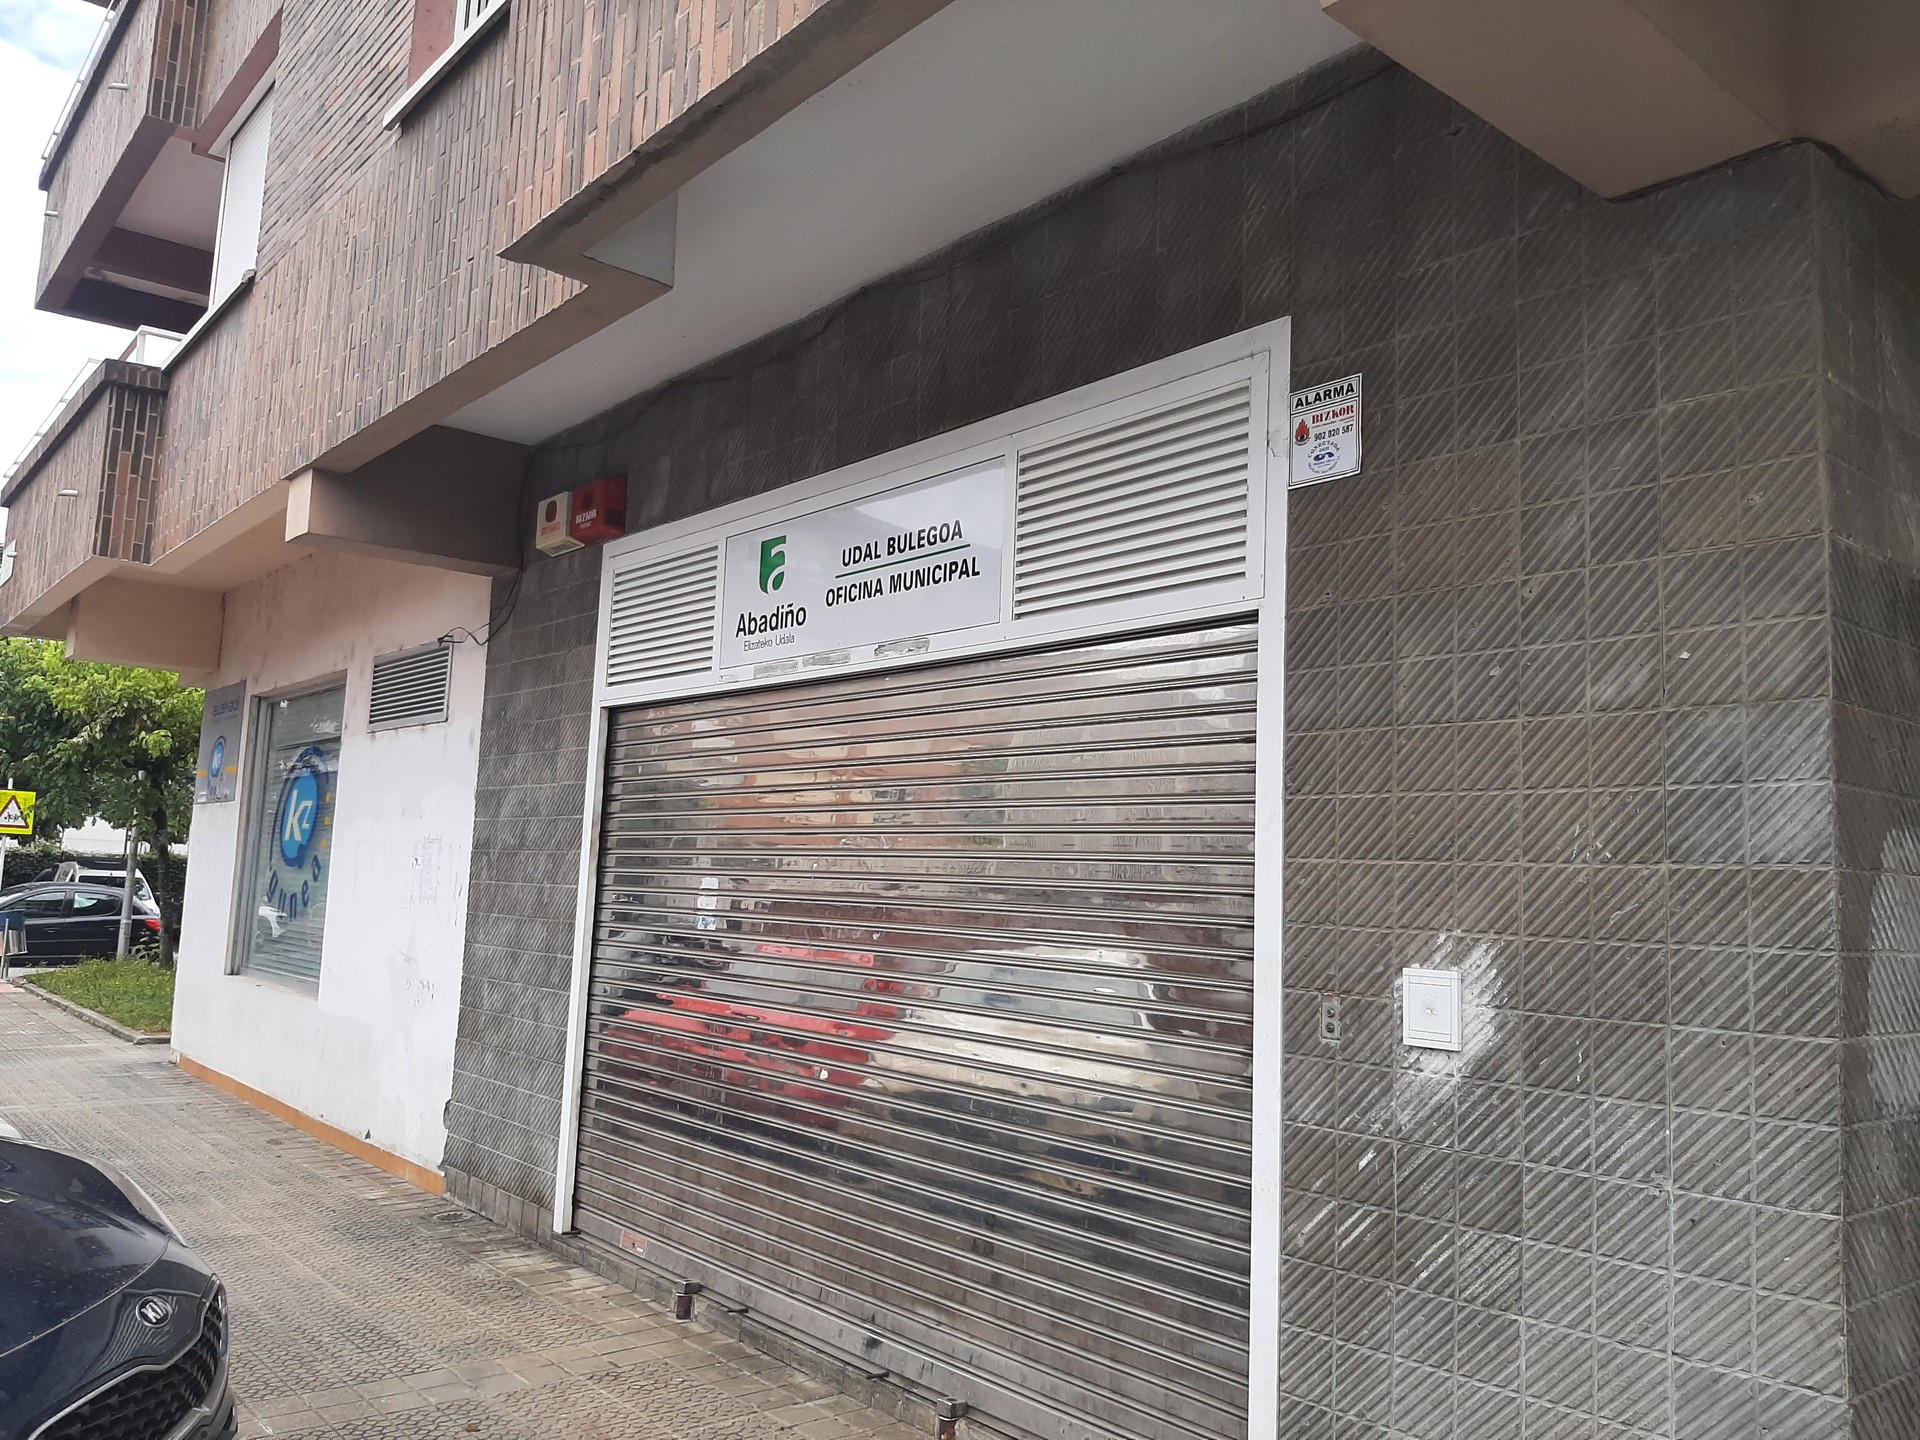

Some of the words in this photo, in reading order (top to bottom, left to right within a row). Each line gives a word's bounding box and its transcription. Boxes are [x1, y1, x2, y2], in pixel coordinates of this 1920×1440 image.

[1295, 383, 1355, 410] ALARMA
[1311, 404, 1354, 424] BIZKOR
[1314, 431, 1326, 441] 902
[1328, 427, 1340, 438] 820
[1341, 423, 1354, 434] 587
[842, 541, 882, 567] UDAL
[887, 520, 963, 556] BULEGOA
[825, 578, 884, 607] OFICINA
[889, 557, 981, 594] MUNICIPAL
[735, 603, 807, 638] Abadiño
[775, 633, 795, 646] Udala
